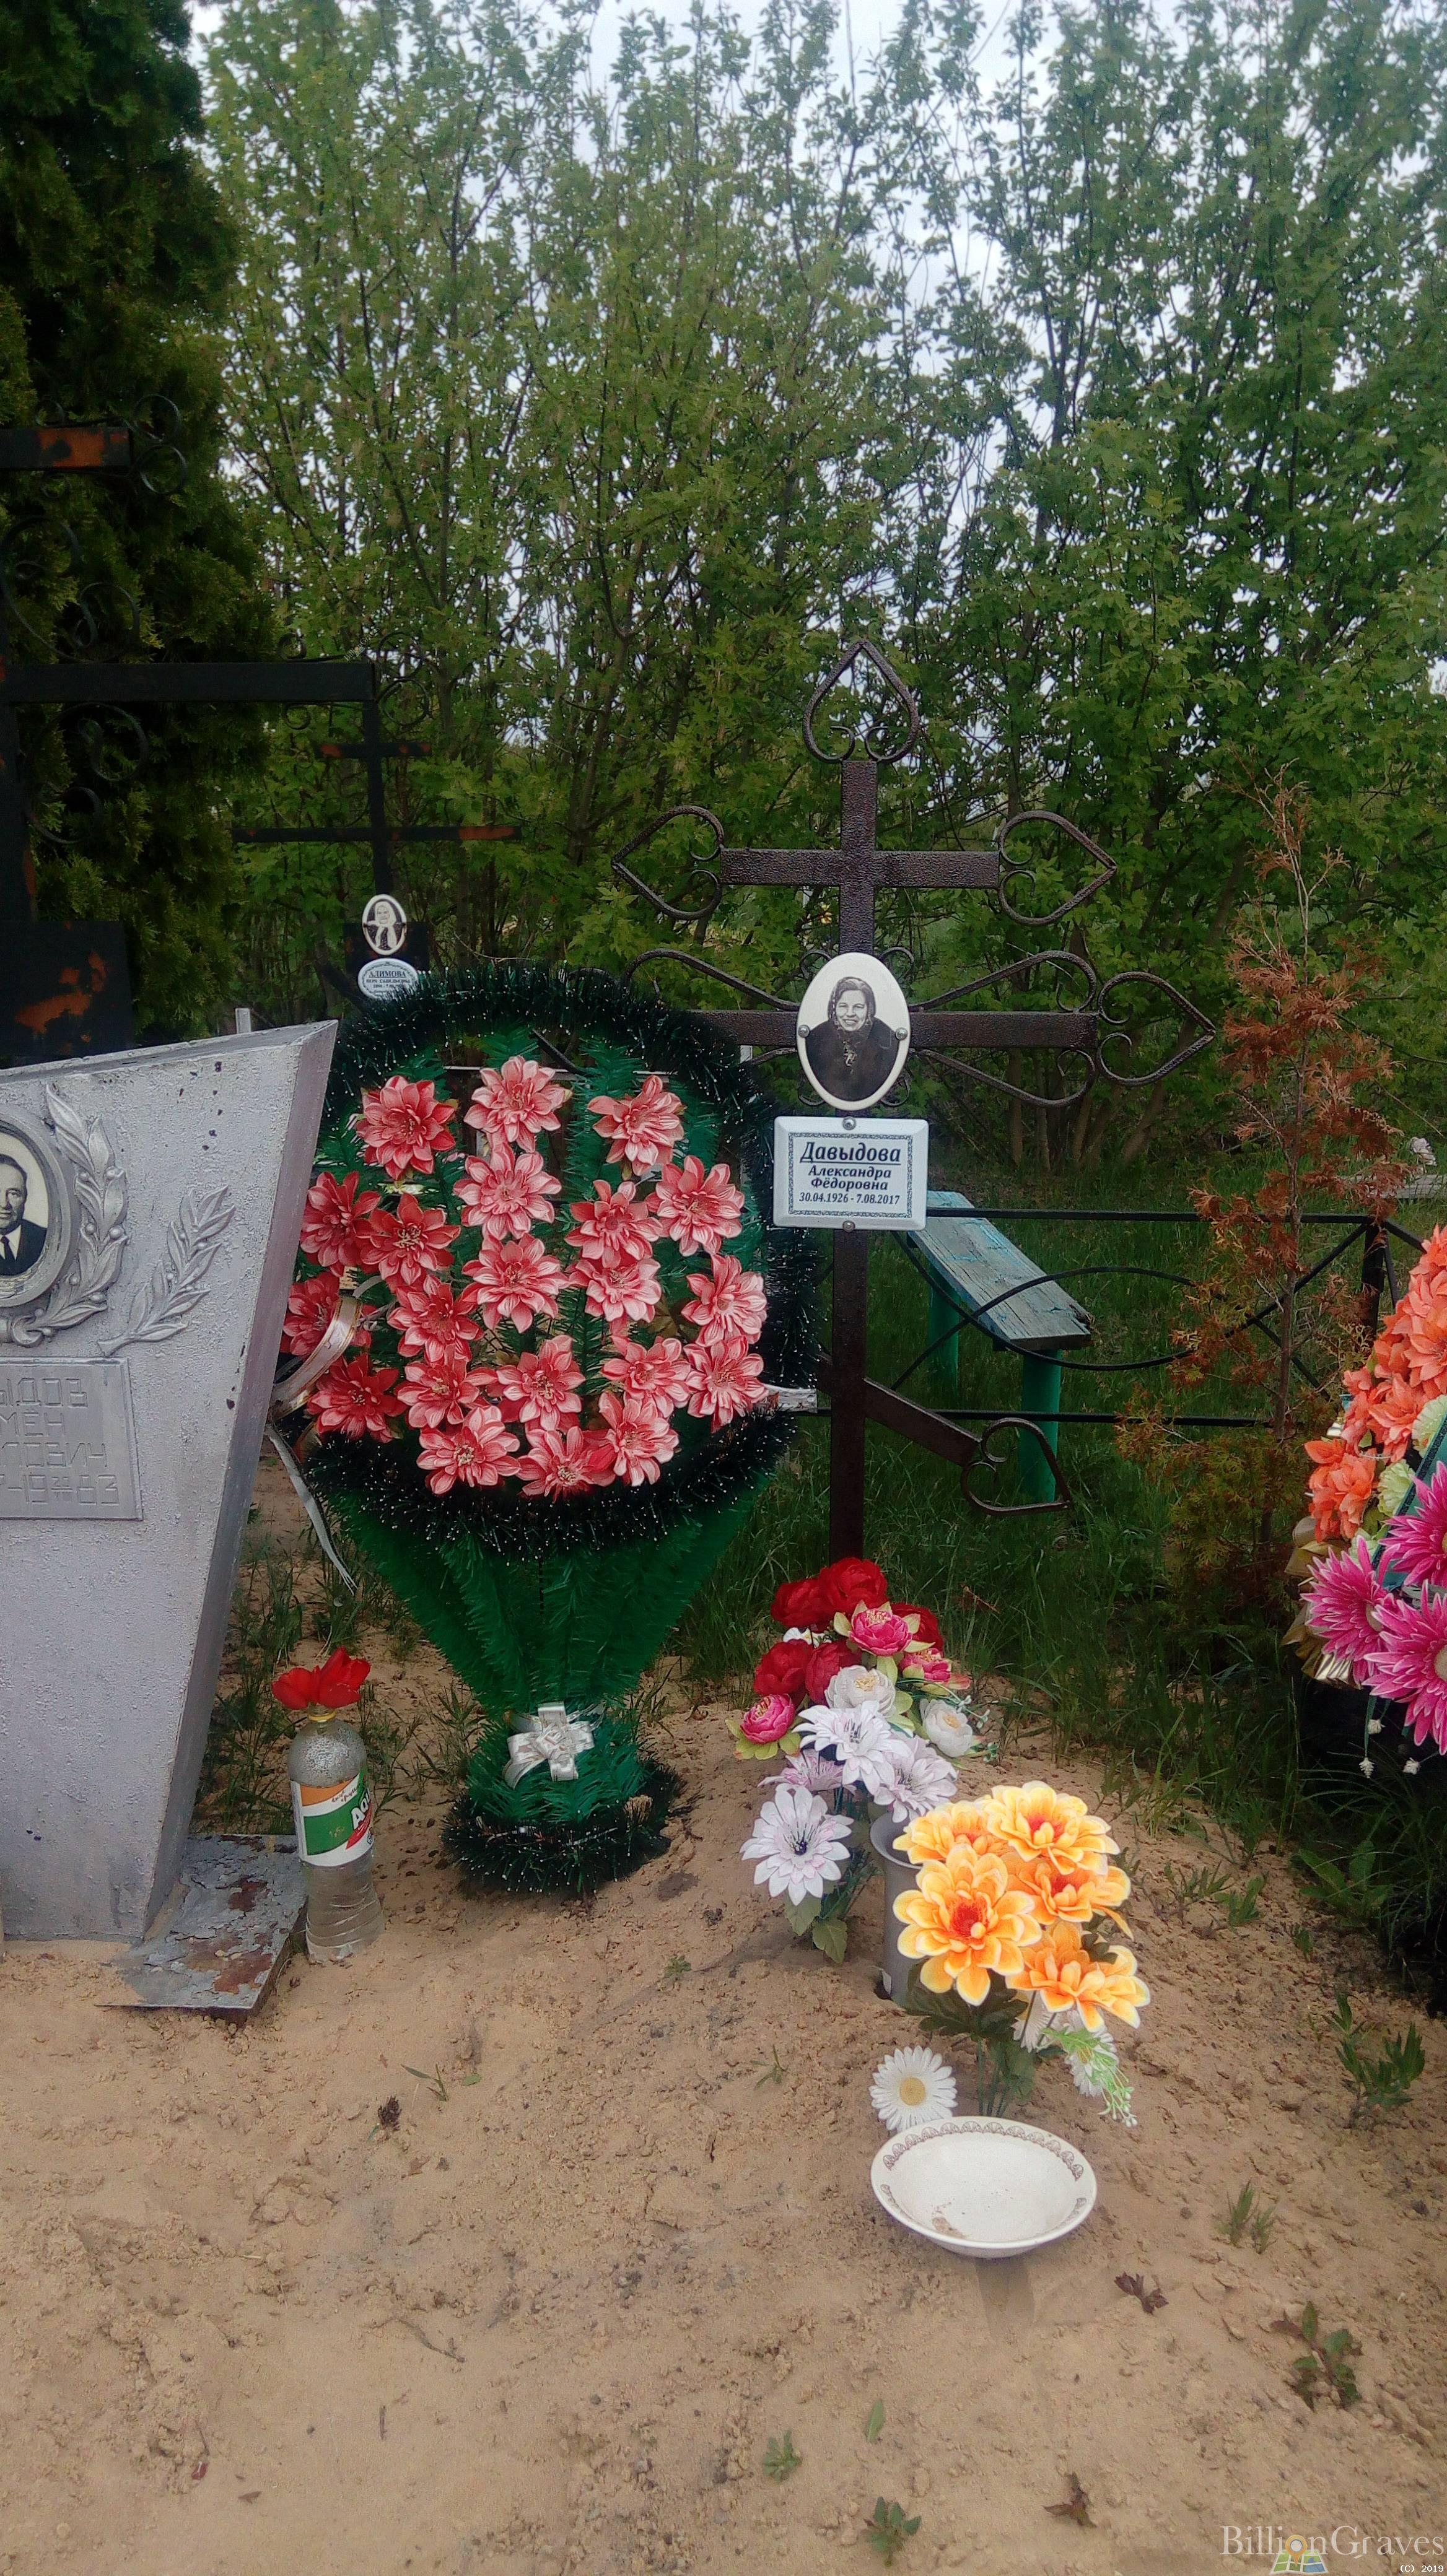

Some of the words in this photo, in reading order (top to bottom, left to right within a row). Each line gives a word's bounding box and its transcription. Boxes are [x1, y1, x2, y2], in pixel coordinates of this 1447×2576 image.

[800, 1142, 901, 1164] Давыдова
[808, 1165, 891, 1181] Александра
[811, 1177, 888, 1191] Фёдоровна
[798, 1192, 849, 1203] 30.04.1926
[856, 1194, 901, 1205] 7.08.2017
